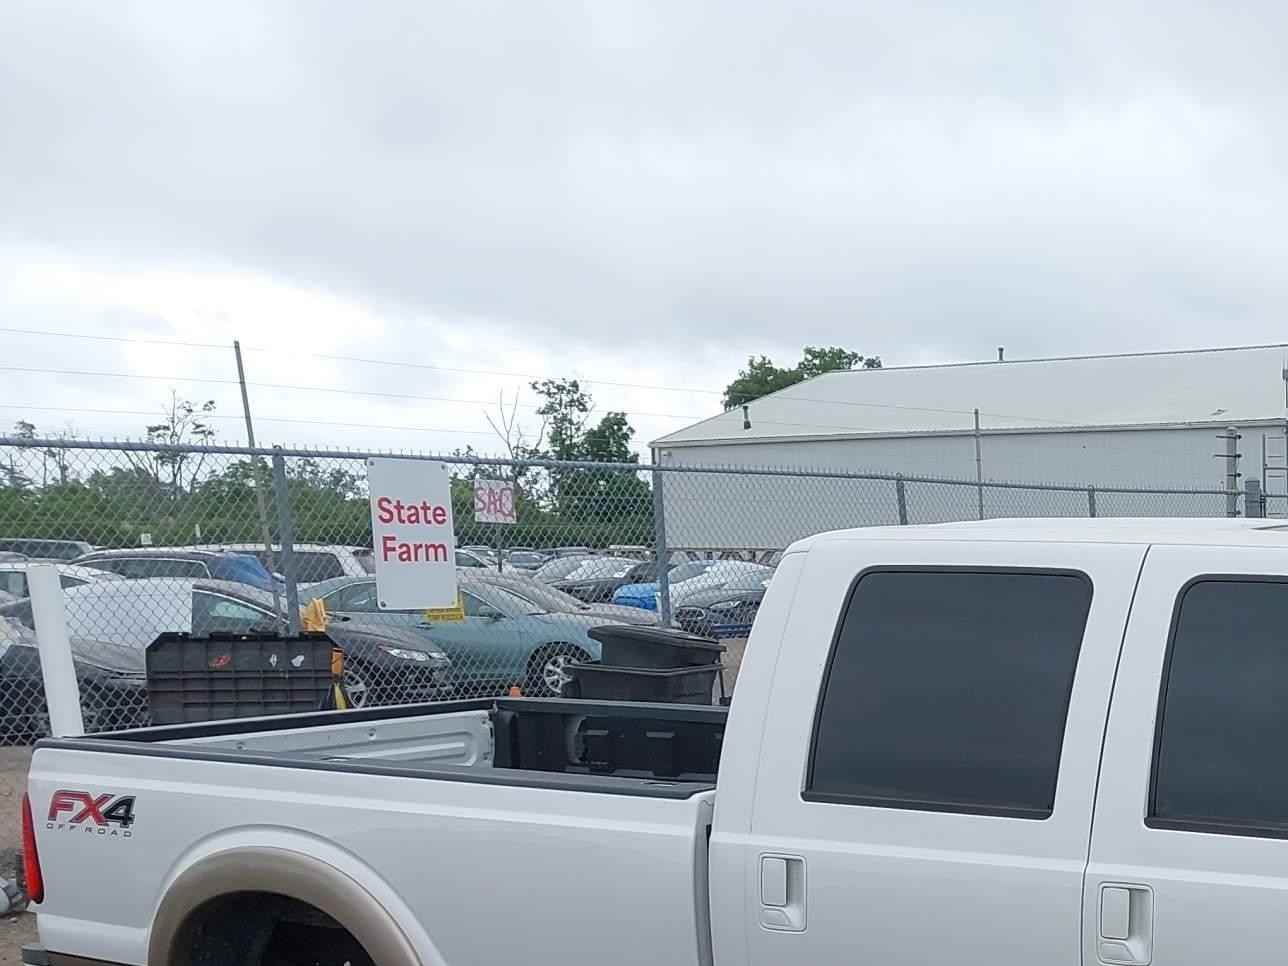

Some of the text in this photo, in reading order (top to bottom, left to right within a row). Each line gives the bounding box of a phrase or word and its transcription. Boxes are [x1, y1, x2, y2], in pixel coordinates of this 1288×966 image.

[377, 497, 447, 524] State
[382, 536, 448, 562] Farm
[48, 790, 136, 829] FX4
[84, 826, 132, 838] ROAD
